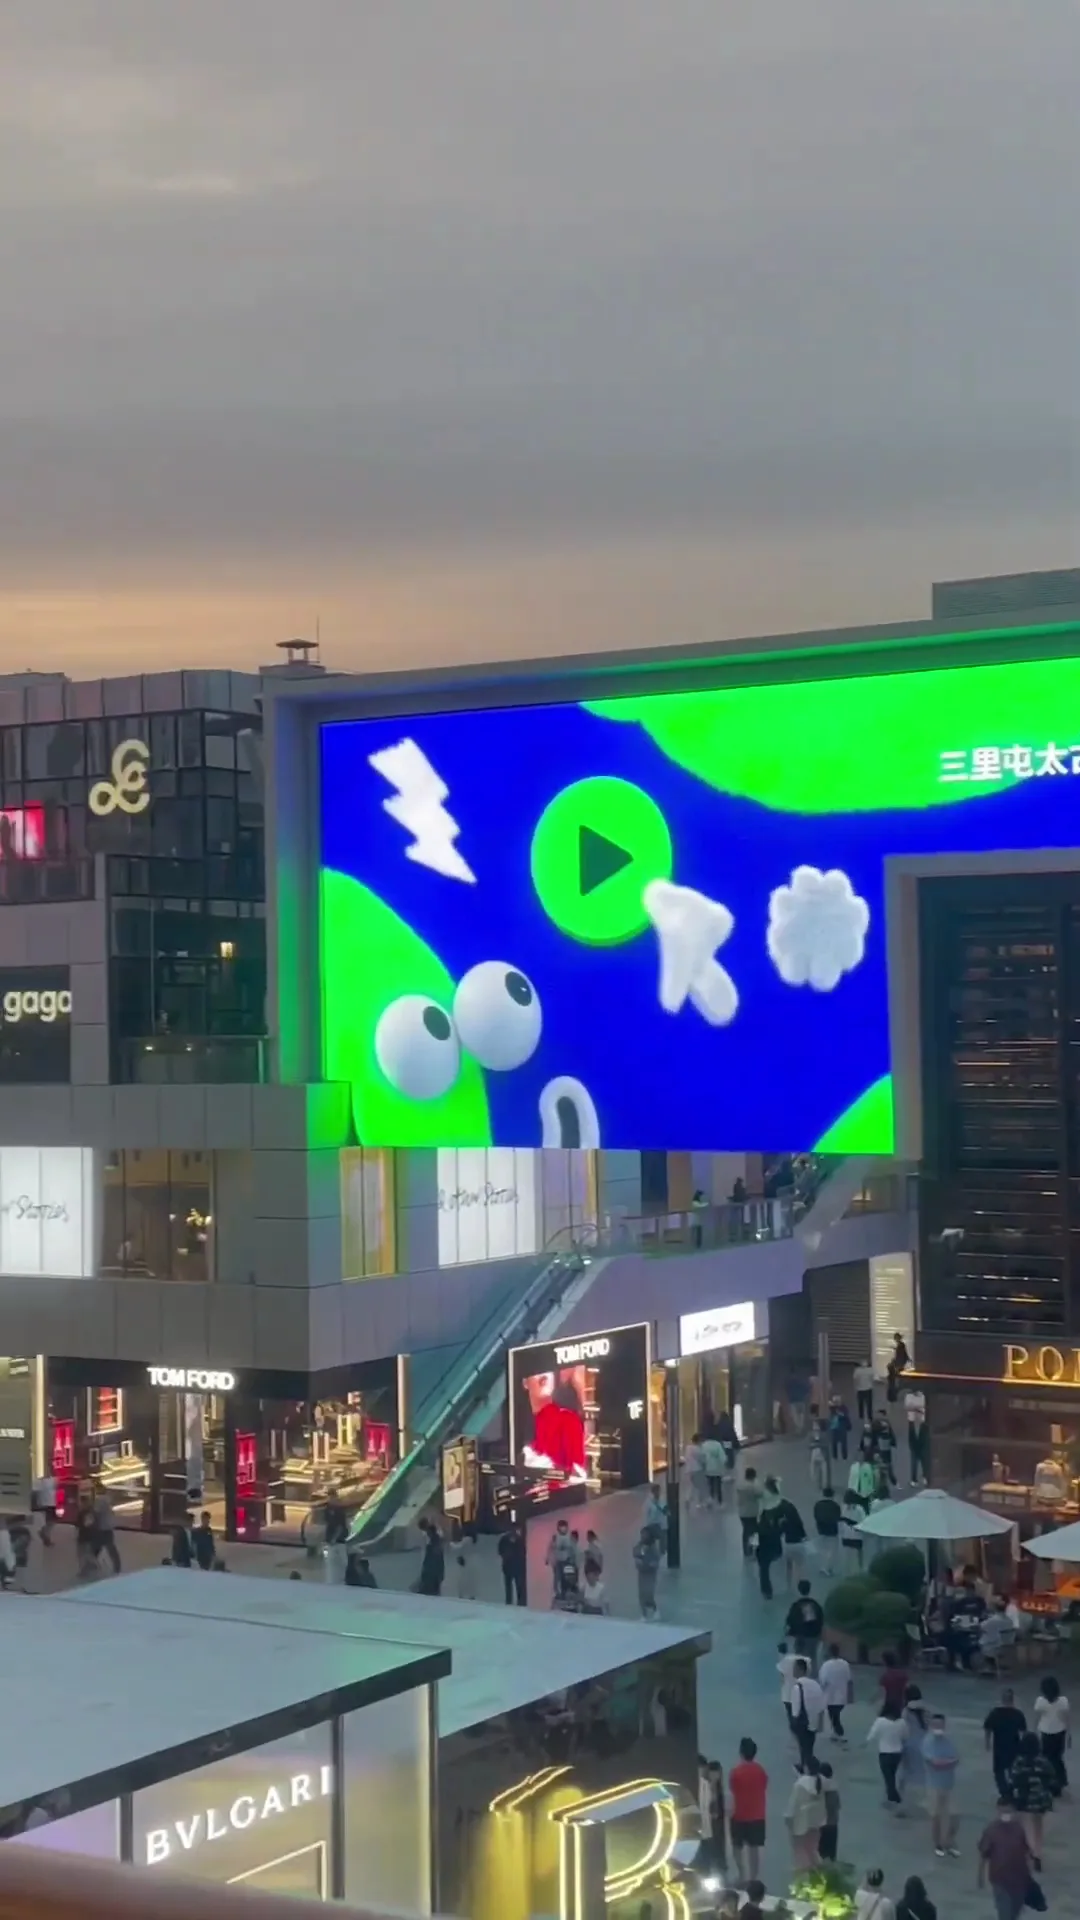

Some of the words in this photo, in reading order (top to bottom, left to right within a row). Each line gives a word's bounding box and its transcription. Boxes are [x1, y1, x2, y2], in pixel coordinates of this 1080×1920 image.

[554, 1344, 579, 1365] TOM
[146, 1367, 185, 1387] TOM
[187, 1369, 235, 1390] FORD
[627, 1400, 643, 1420] TF
[145, 1765, 331, 1865] BVLGARI
